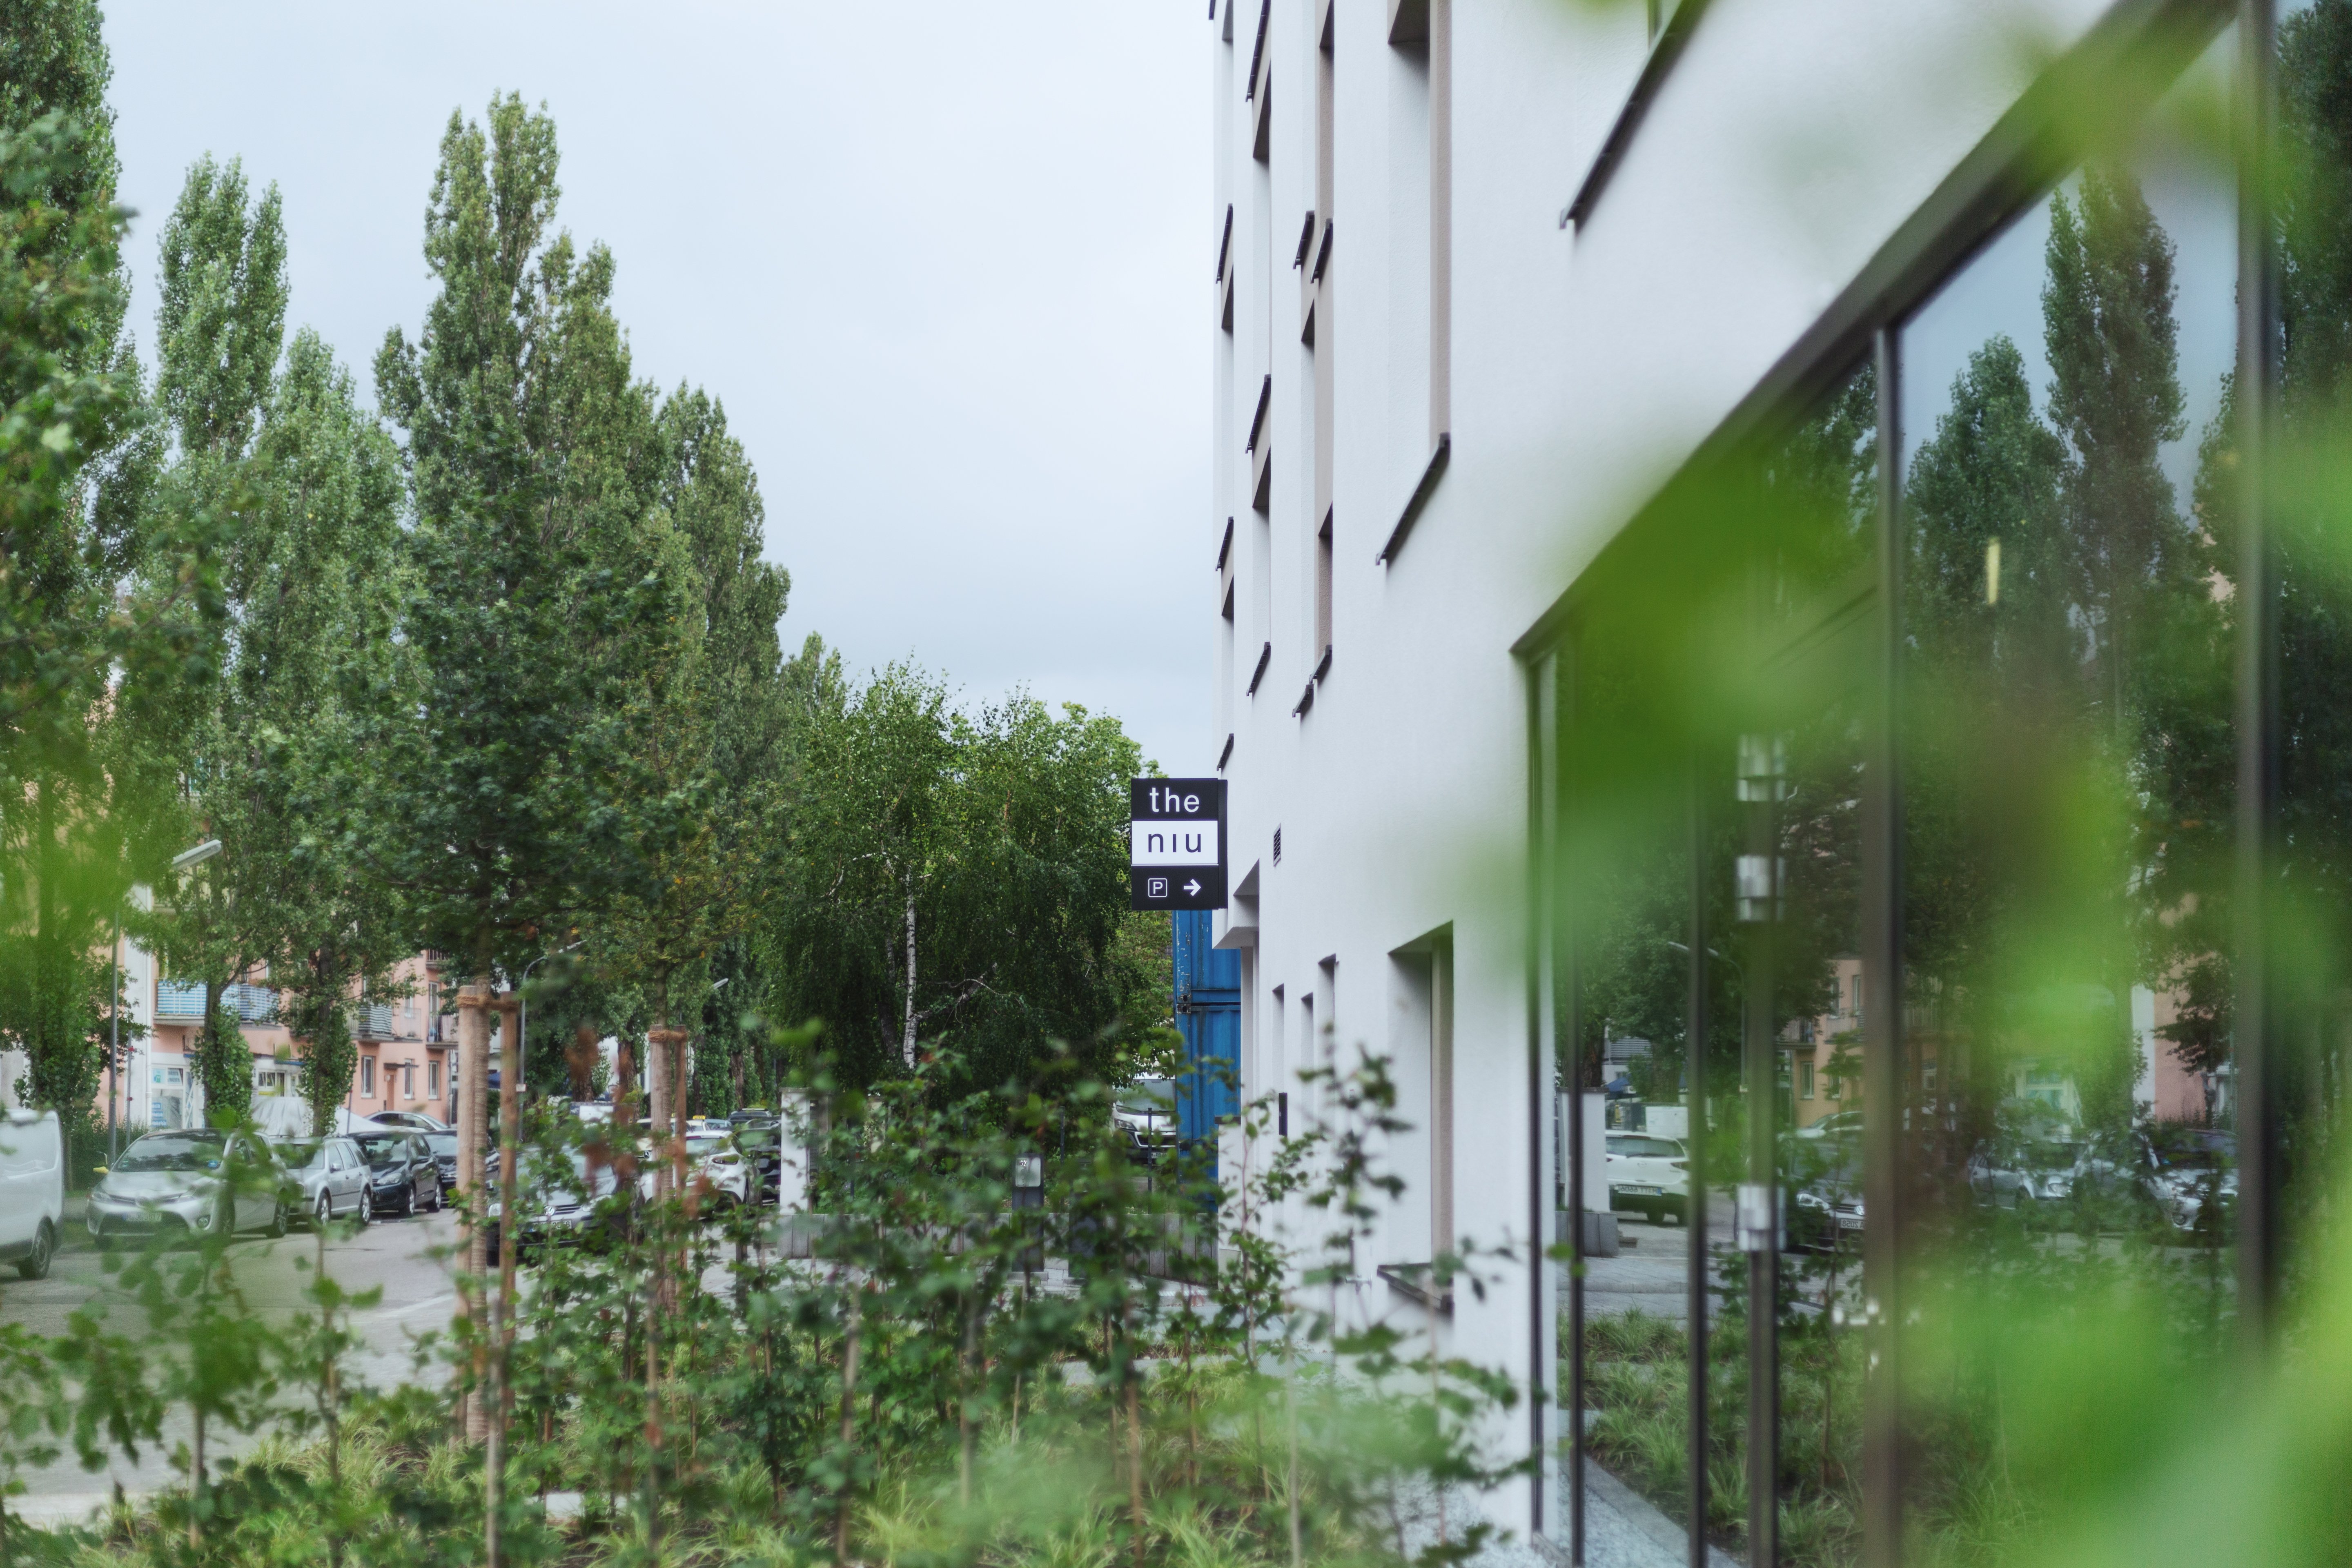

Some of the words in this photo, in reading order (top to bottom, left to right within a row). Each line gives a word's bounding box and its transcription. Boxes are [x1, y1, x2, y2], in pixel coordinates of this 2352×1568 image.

[1149, 787, 1200, 813] the
[1148, 833, 1201, 853] niu
[1153, 881, 1163, 894] P
